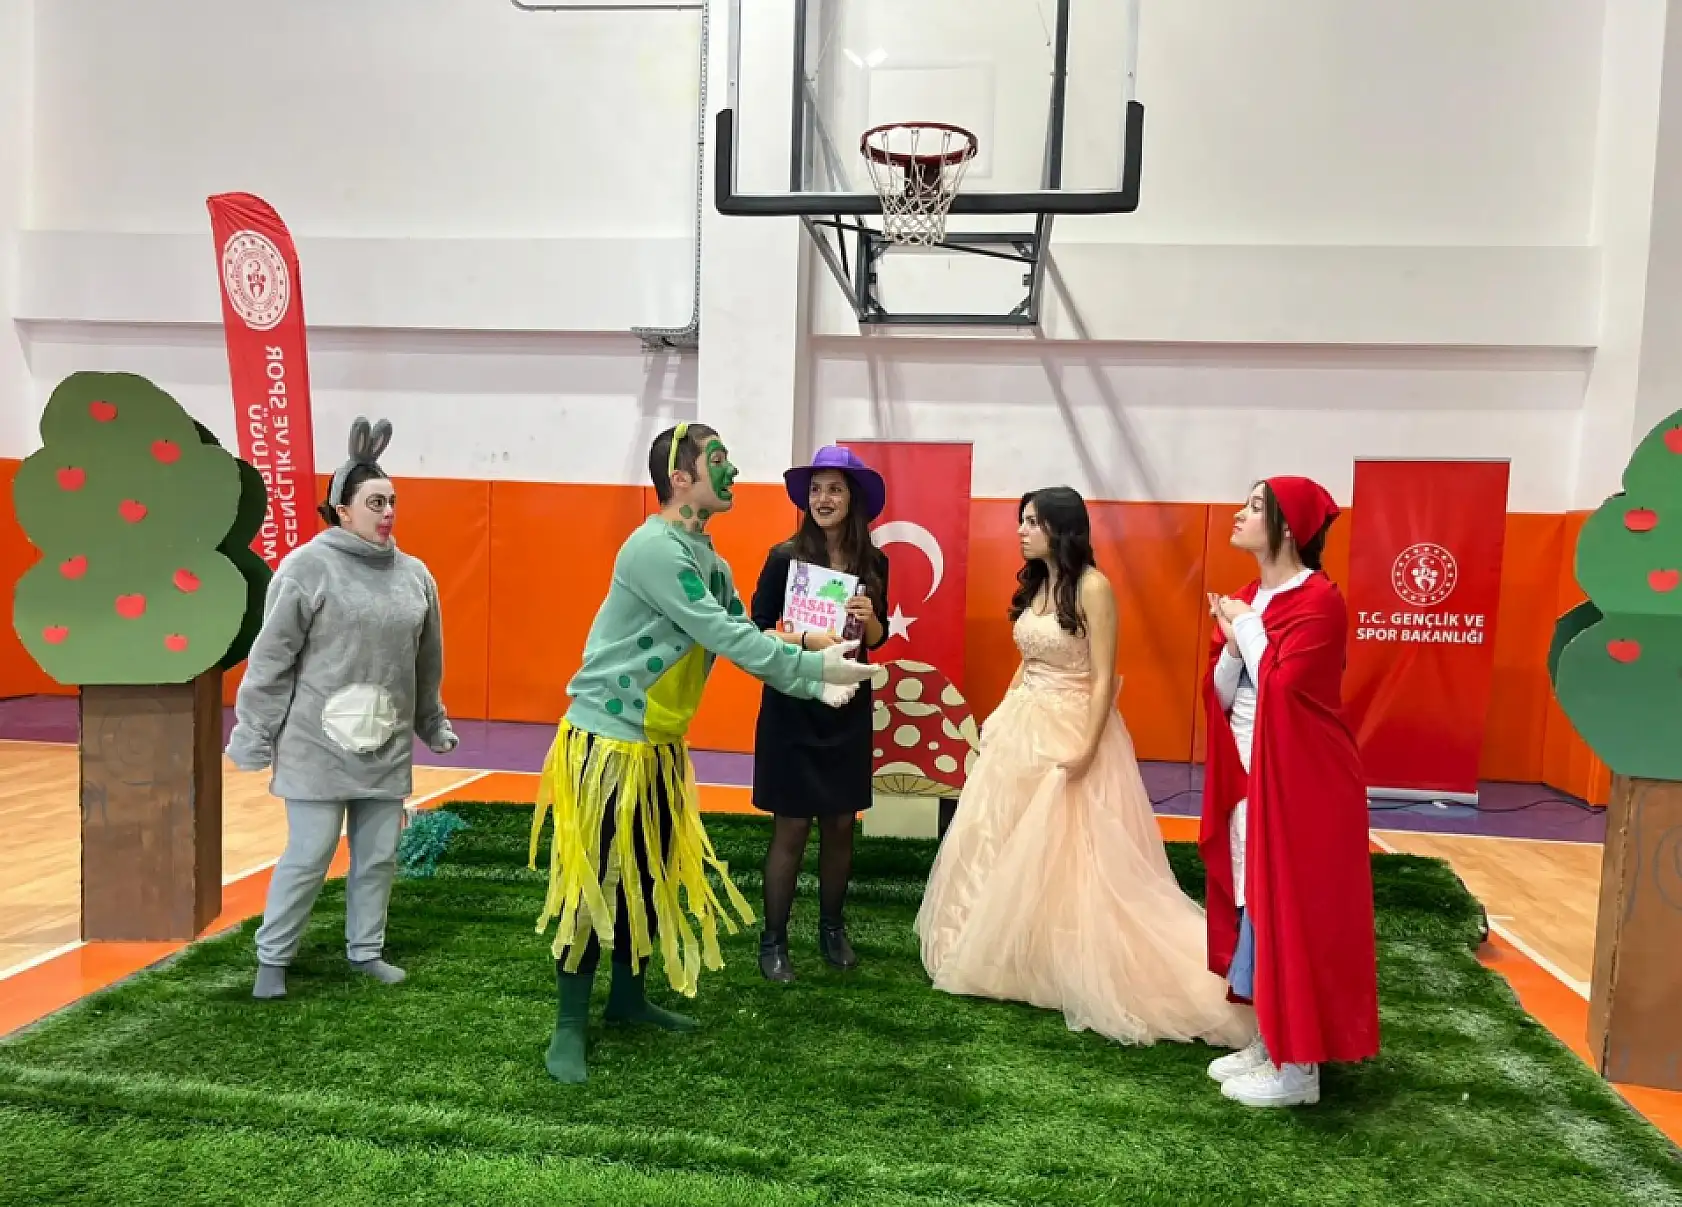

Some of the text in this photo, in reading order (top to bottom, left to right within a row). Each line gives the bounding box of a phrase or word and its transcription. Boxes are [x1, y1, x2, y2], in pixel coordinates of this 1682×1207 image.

[1358, 611, 1485, 628] T.C. GENÇLİK VE
[1356, 627, 1484, 645] SPOR BAKANLIĞI
